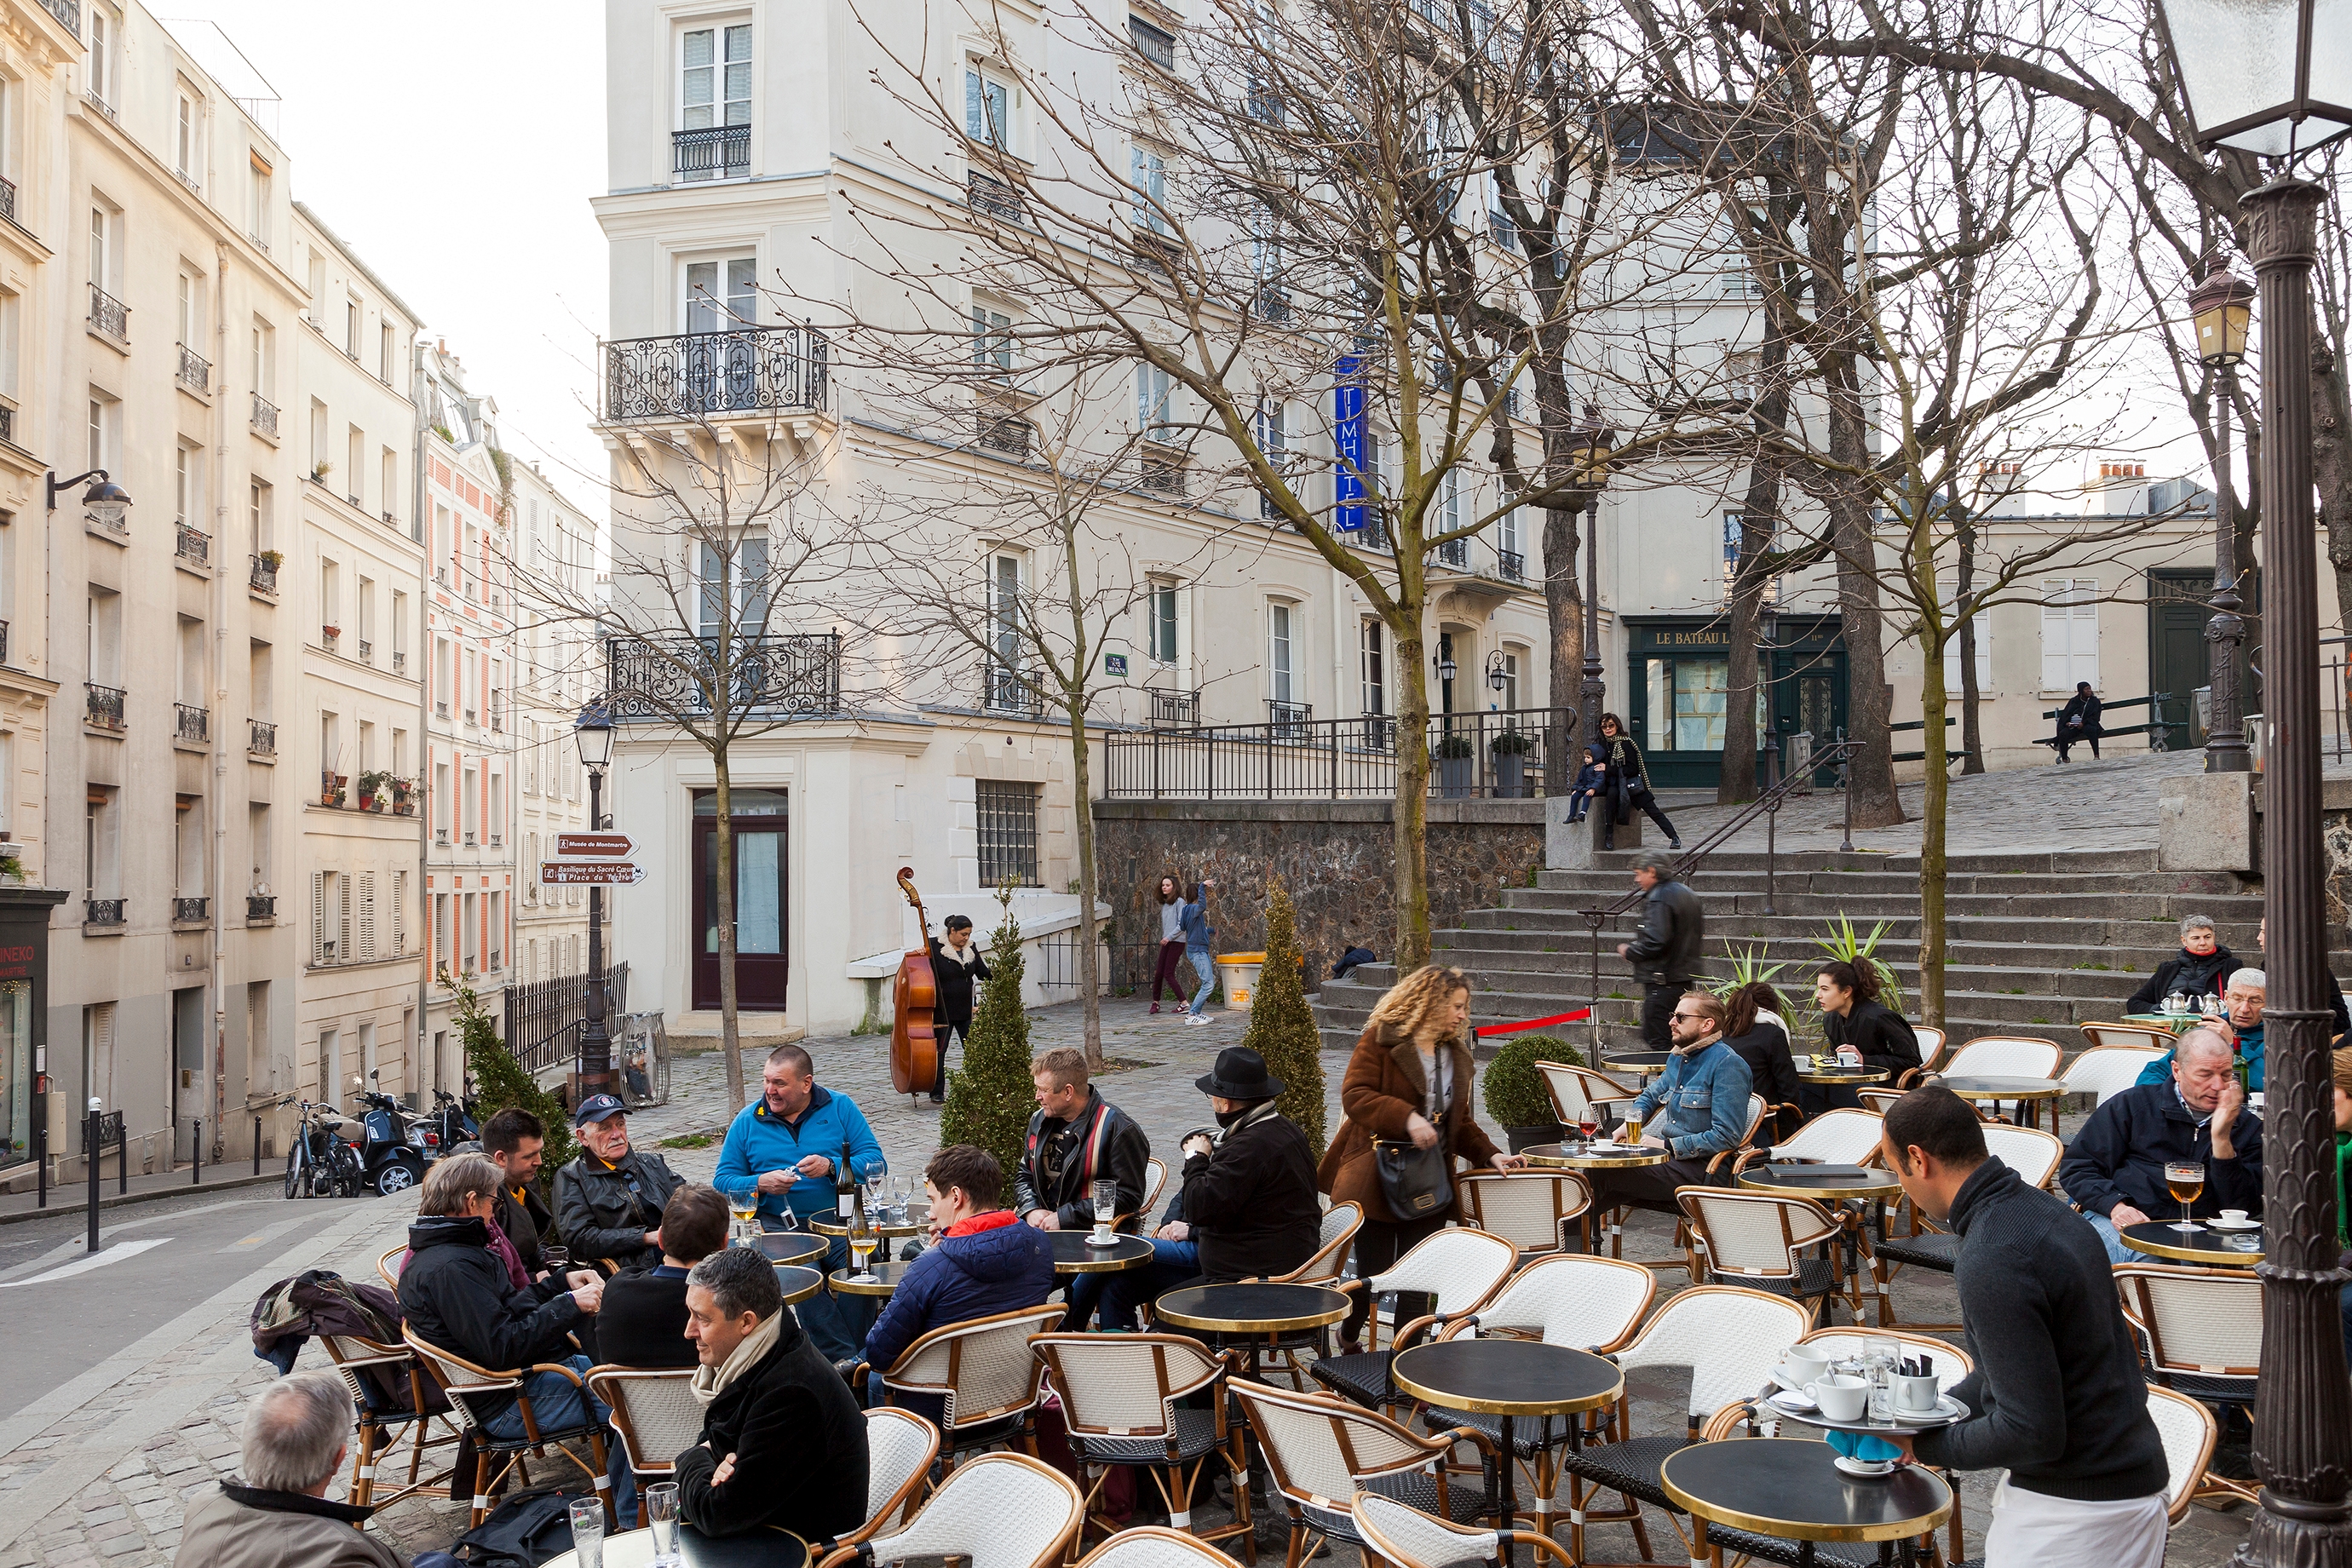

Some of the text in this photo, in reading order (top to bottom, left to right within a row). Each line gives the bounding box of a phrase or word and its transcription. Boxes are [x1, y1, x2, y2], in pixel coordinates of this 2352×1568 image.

[1656, 633, 1671, 645] LE
[1675, 632, 1719, 645] BATEAU
[558, 865, 586, 874] Basilique
[0, 945, 34, 962] INEKO
